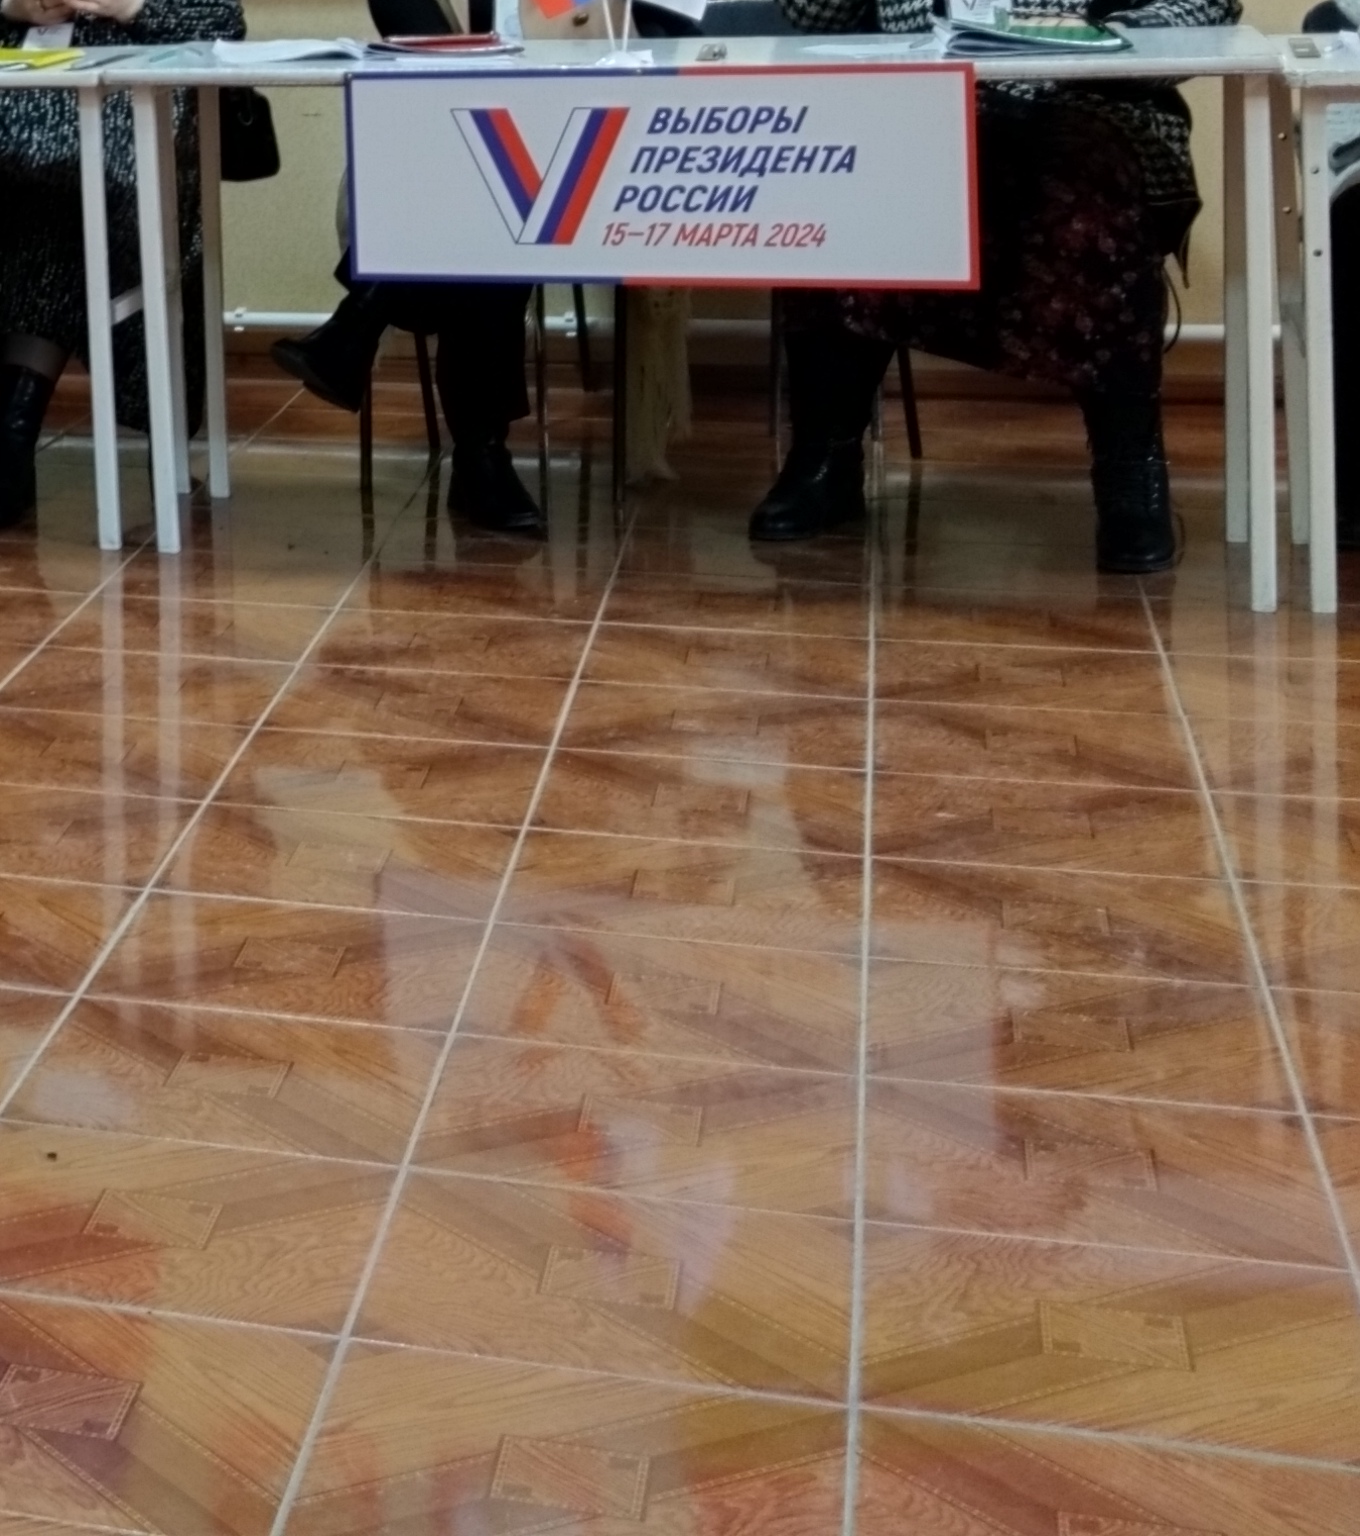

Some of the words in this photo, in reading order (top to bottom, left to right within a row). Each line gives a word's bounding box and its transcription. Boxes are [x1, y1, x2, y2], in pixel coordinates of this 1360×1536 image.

[646, 106, 810, 135] ВЫБОРЫ
[629, 144, 858, 178] ПРЕЗИДЕНТА
[613, 184, 760, 213] РОССИИ
[672, 222, 760, 248] МАРТА
[763, 222, 828, 248] 2024
